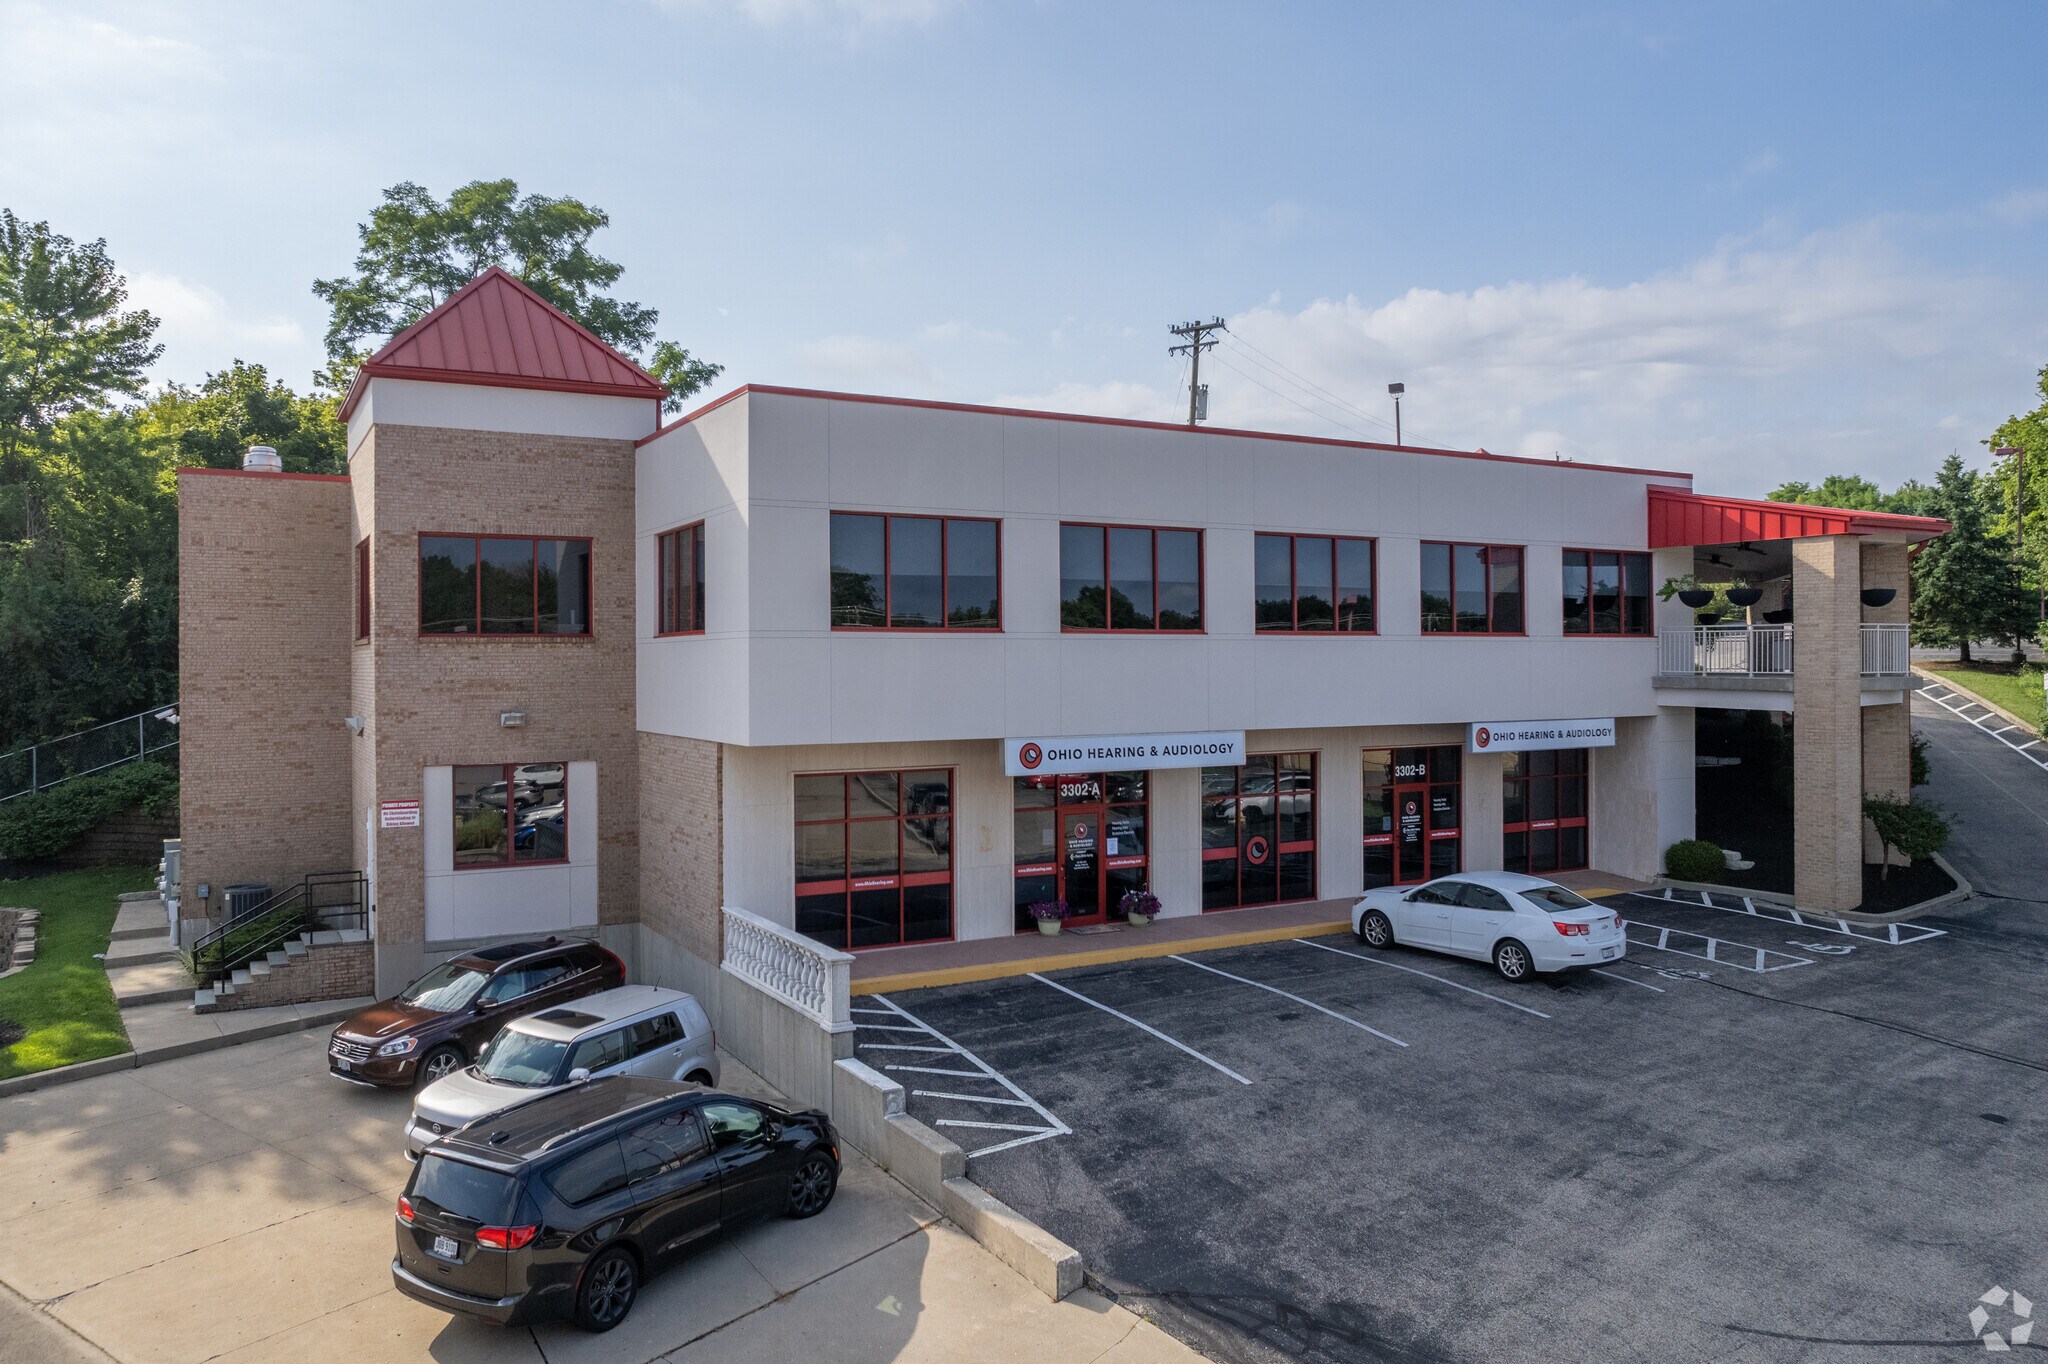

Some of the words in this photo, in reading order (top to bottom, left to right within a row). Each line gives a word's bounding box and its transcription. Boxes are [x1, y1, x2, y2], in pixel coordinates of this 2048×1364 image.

[1493, 732, 1516, 742] OHIO
[1518, 730, 1555, 740] HEARING
[1557, 730, 1563, 739] &
[1566, 728, 1612, 738] AUDIOLOGY
[1047, 749, 1083, 760] OHIO
[1087, 746, 1145, 759] HEARING
[1150, 745, 1158, 756] &
[1162, 743, 1234, 756] AUDIOLOGY
[1395, 764, 1426, 777] 3302-B
